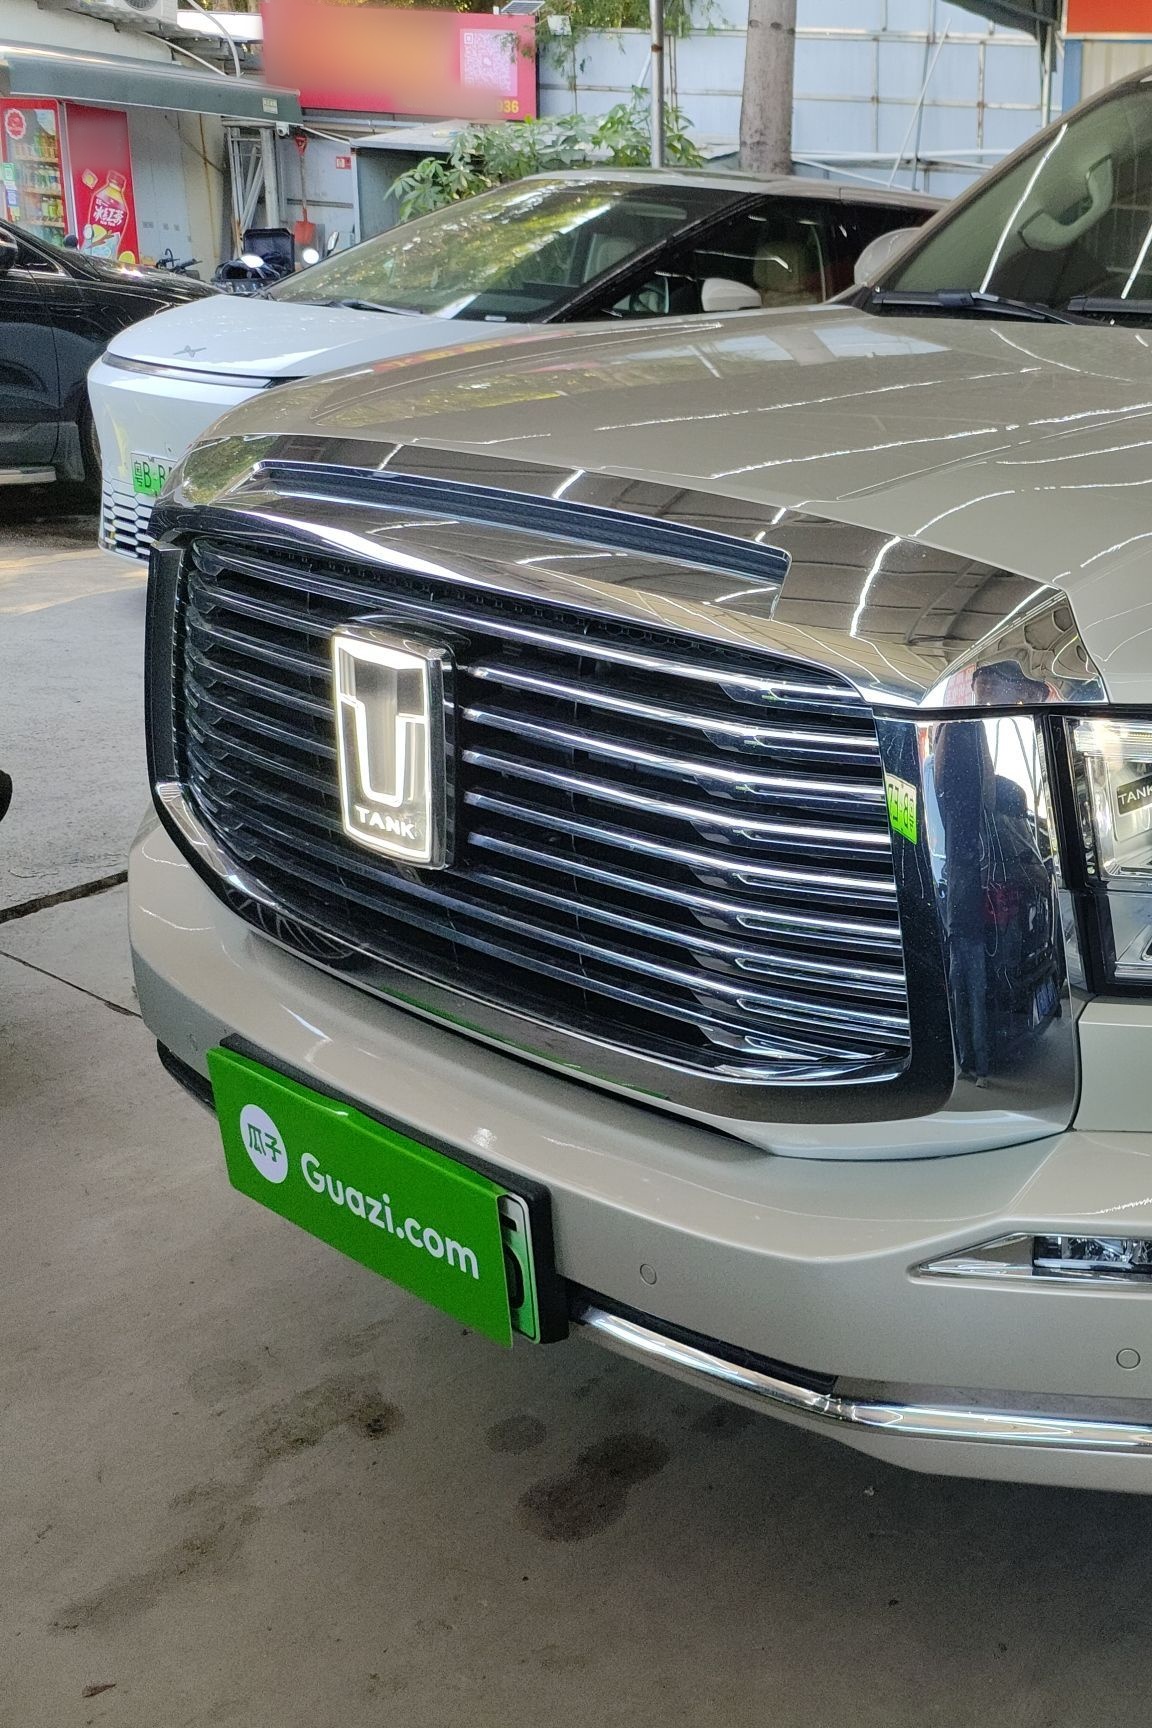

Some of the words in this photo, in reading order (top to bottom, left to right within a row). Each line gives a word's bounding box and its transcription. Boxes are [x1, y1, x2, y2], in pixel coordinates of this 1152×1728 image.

[355, 805, 416, 840] TANK
[247, 1122, 282, 1163] 瓜子
[301, 1153, 479, 1280] Guazi.com
